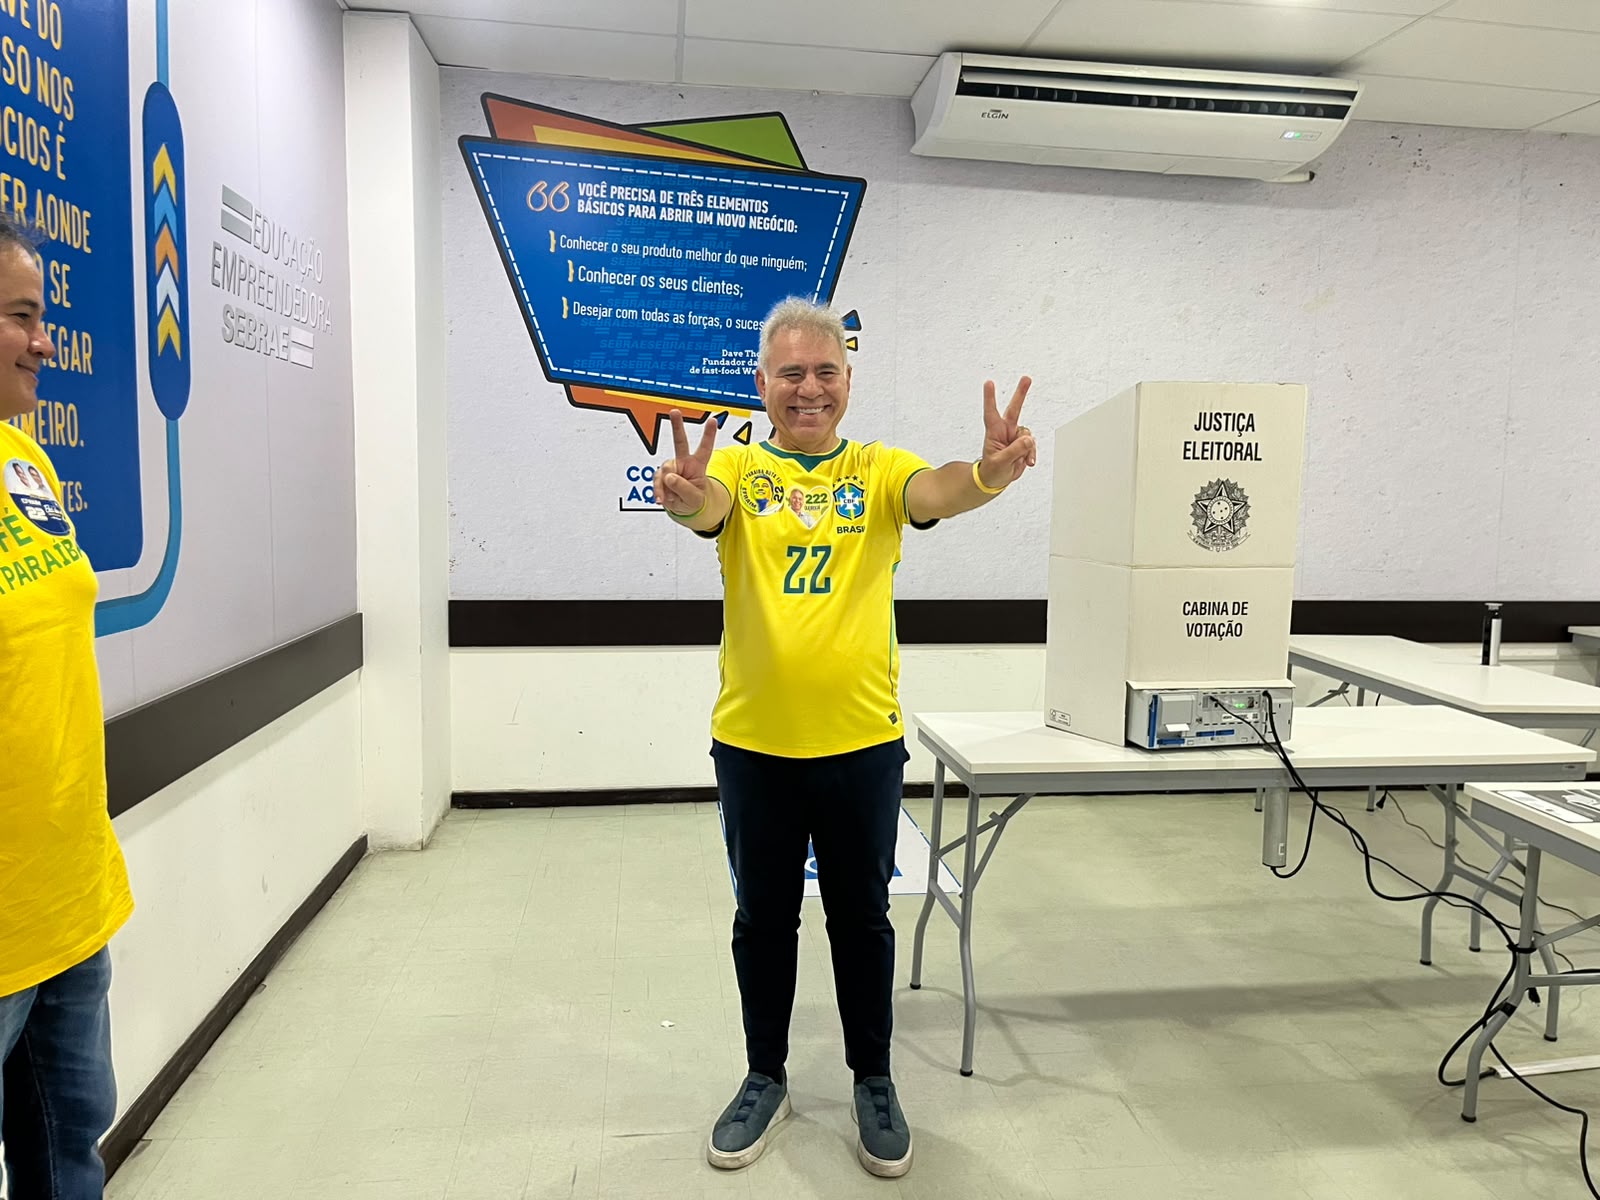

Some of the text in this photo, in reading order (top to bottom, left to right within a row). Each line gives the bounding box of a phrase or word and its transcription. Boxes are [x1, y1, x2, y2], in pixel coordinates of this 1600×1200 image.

[37, 0, 62, 51] DO
[2, 35, 74, 121] SO NOS
[981, 111, 1009, 119] ELGIN
[0, 105, 66, 181] CIOS É
[0, 172, 92, 254] ER AONDE
[578, 181, 769, 213] VOCÊ PRECISA DE TRÊS ELEMENTOS
[577, 197, 798, 233] BÁSICOS PARA ABRIR UM NOVO NEGÓCIO:
[253, 208, 323, 284] EDUCAÇÃO
[560, 234, 808, 273] Conhecer o seu produto melhor do que ninguém;
[50, 259, 71, 308] SE
[211, 240, 333, 335] EMPREENDEDORA
[578, 265, 744, 298] Conhecer os seus clientes;
[573, 301, 613, 320] Desejar
[615, 308, 638, 320] com
[641, 308, 670, 323] todas
[672, 313, 685, 324] as
[688, 311, 723, 329] forças,
[726, 318, 733, 328] o
[735, 319, 764, 331] suces
[40, 321, 93, 375] EGAR
[222, 304, 290, 361] SEBRAE
[702, 358, 746, 366] Fundador
[722, 349, 743, 357] Dave
[689, 366, 700, 374] de
[702, 367, 740, 375] fast-food
[742, 367, 757, 375] We
[1194, 412, 1255, 437] JUSTIÇA
[1183, 441, 1262, 461] ELEITORAL
[626, 465, 659, 482] CO
[60, 481, 88, 513] TES.
[627, 486, 657, 504] AQ
[773, 485, 784, 504] 22
[805, 493, 828, 504] 222
[784, 545, 831, 593] 22
[1182, 601, 1248, 616] CABINA DE
[1186, 620, 1243, 641] VOTAÇÃO
